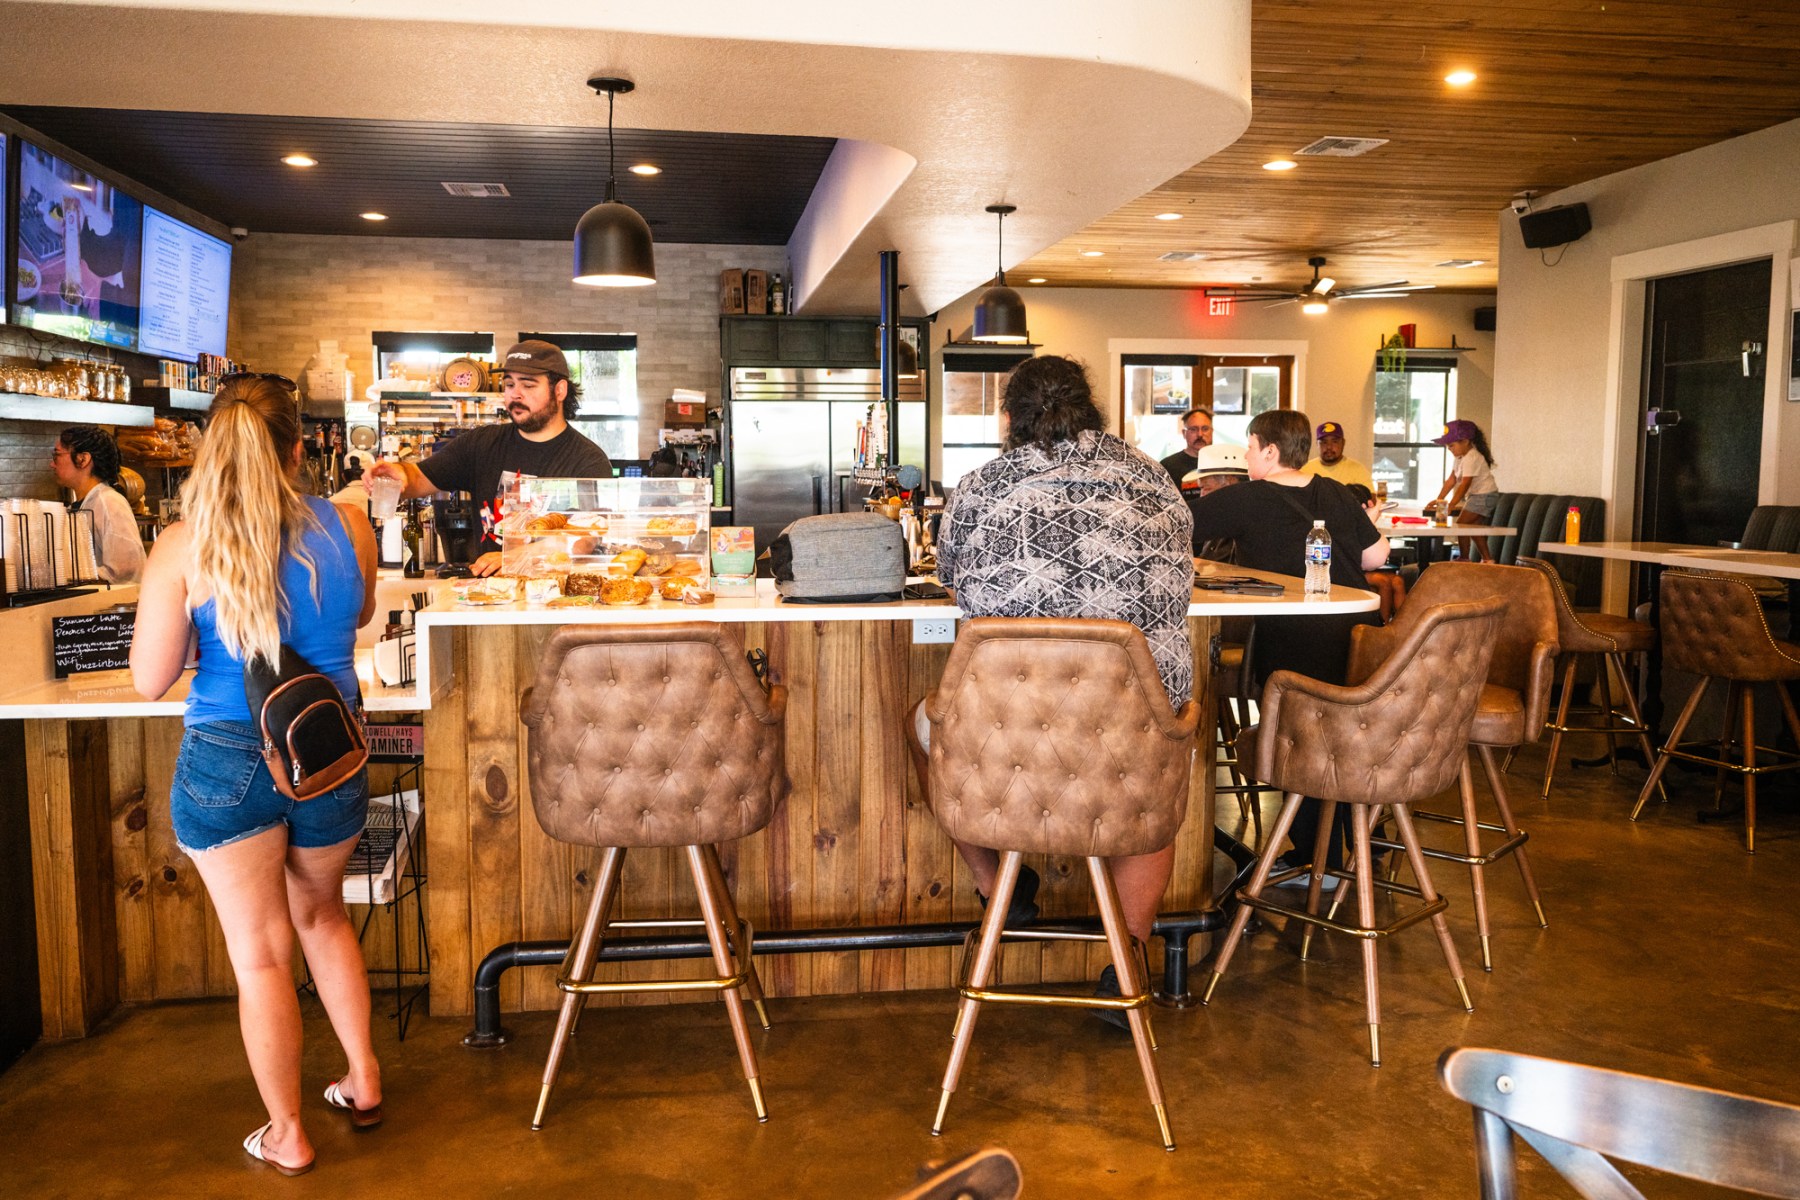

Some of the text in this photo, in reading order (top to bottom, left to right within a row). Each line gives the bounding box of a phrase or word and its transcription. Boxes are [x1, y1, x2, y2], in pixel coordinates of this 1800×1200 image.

[1210, 297, 1231, 315] EXIT
[59, 614, 122, 627] Summer Latte
[55, 628, 85, 638] Peaches
[91, 624, 116, 633] Cream
[75, 658, 130, 671] buzzinbud
[365, 727, 413, 737] LDWELL/HAYS
[367, 738, 413, 754] AMINER
